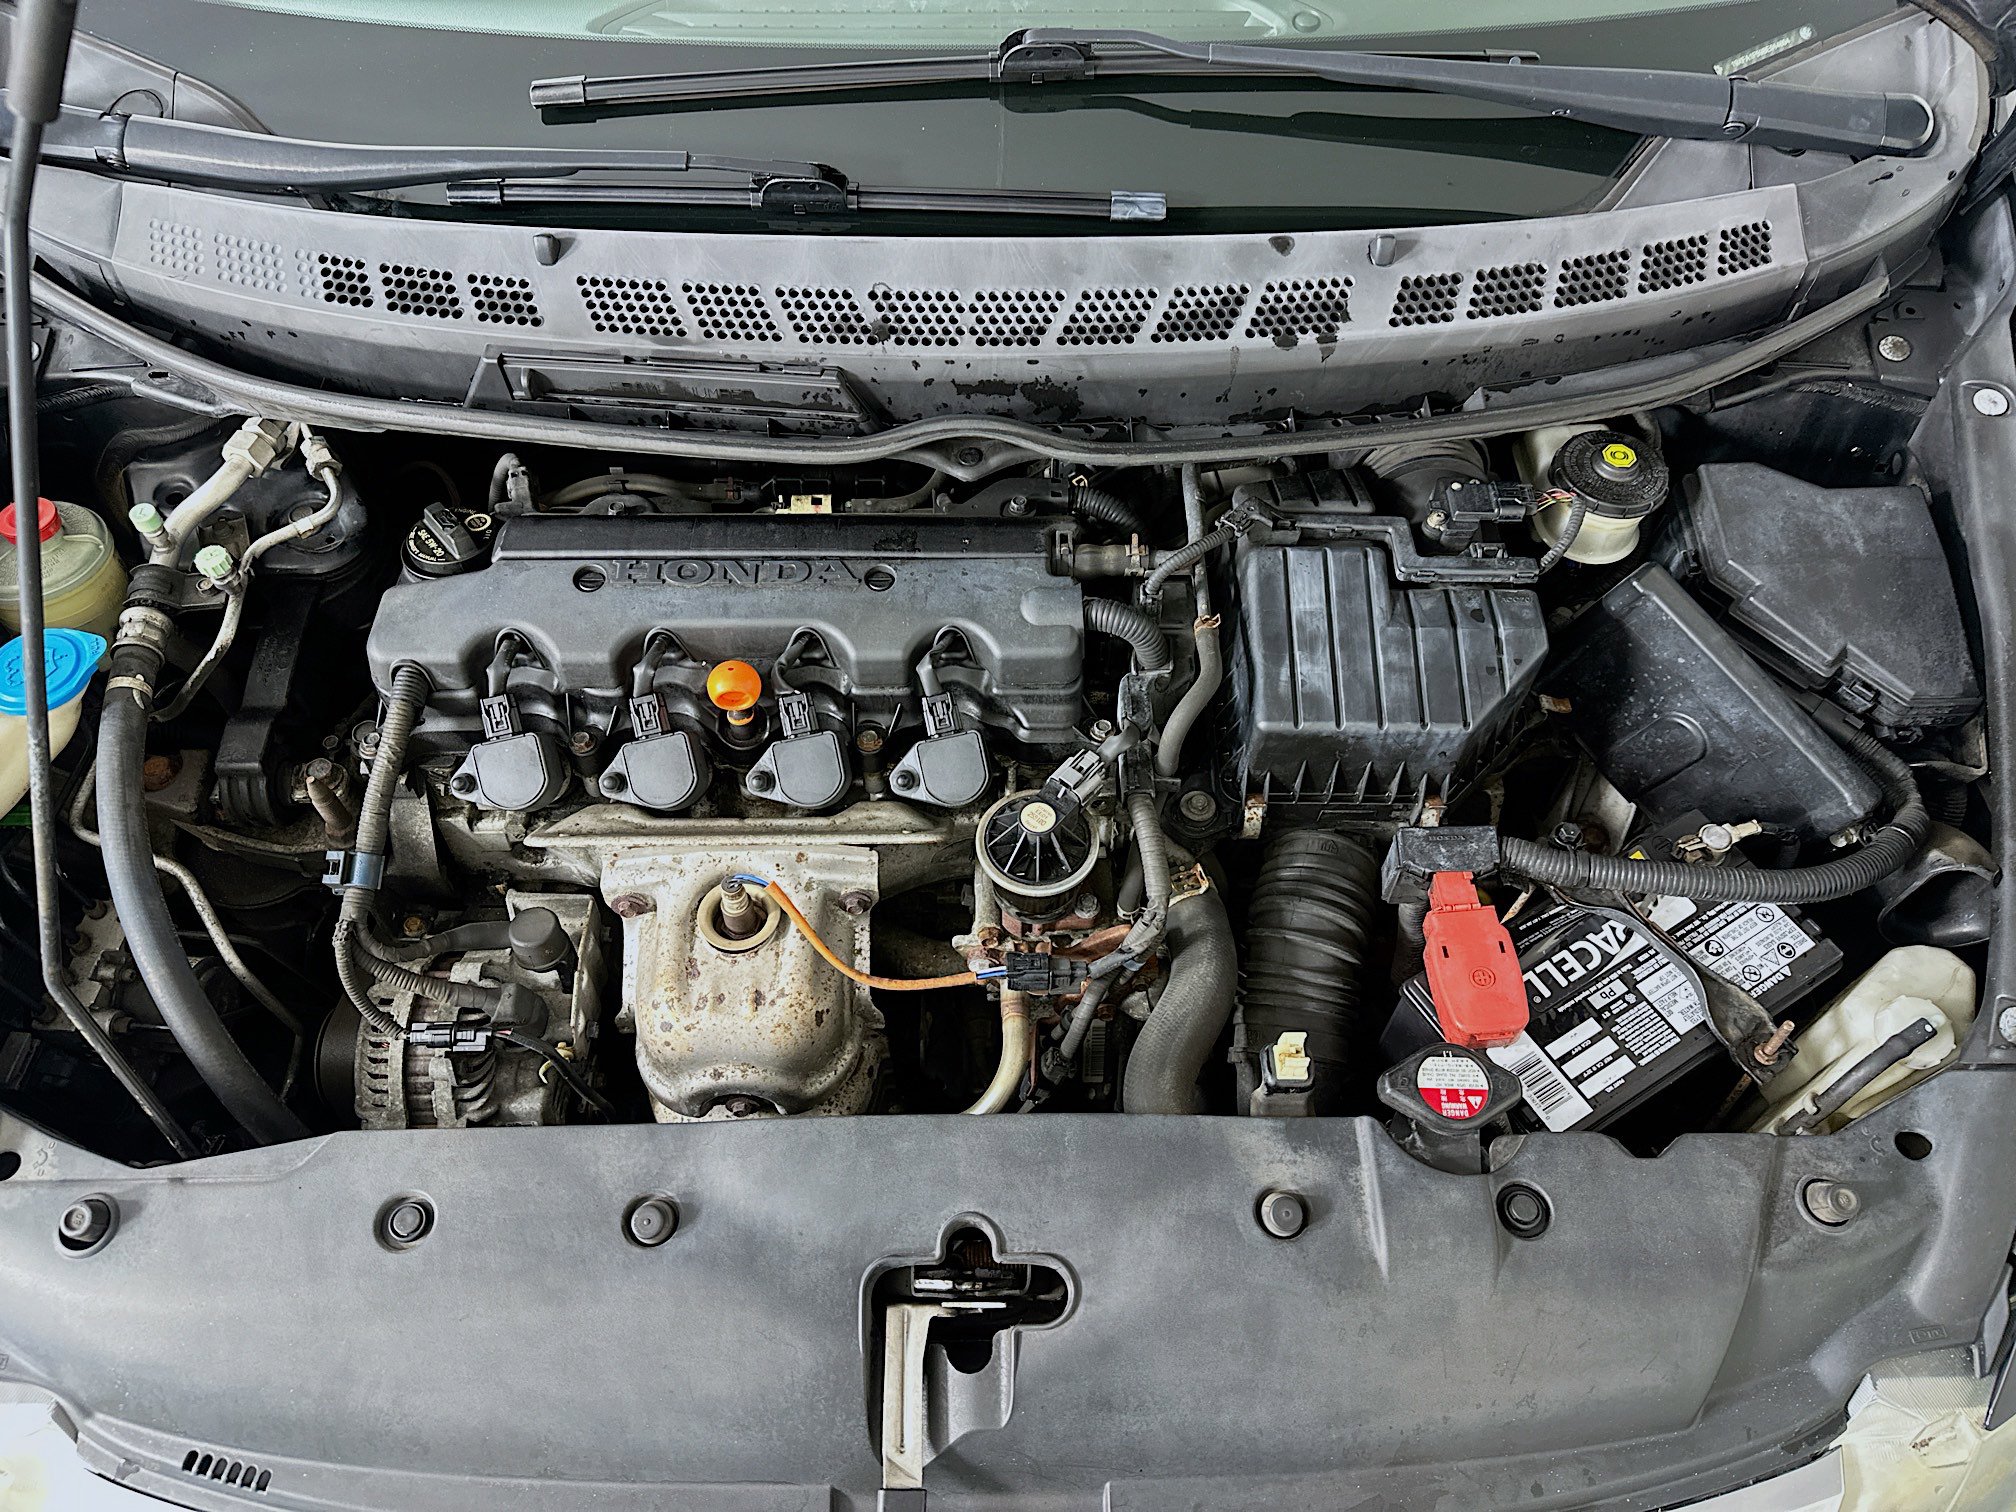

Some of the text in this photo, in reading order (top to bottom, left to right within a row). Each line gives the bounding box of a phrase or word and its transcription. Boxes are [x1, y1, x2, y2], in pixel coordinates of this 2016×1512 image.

[425, 538, 445, 556] 5W-20
[611, 559, 863, 587] HONDA
[1428, 834, 1466, 842] HONDA
[1747, 971, 1785, 998] DANGER
[1599, 987, 1616, 1001] Pb
[1681, 1006, 1702, 1021] EDIATELY
